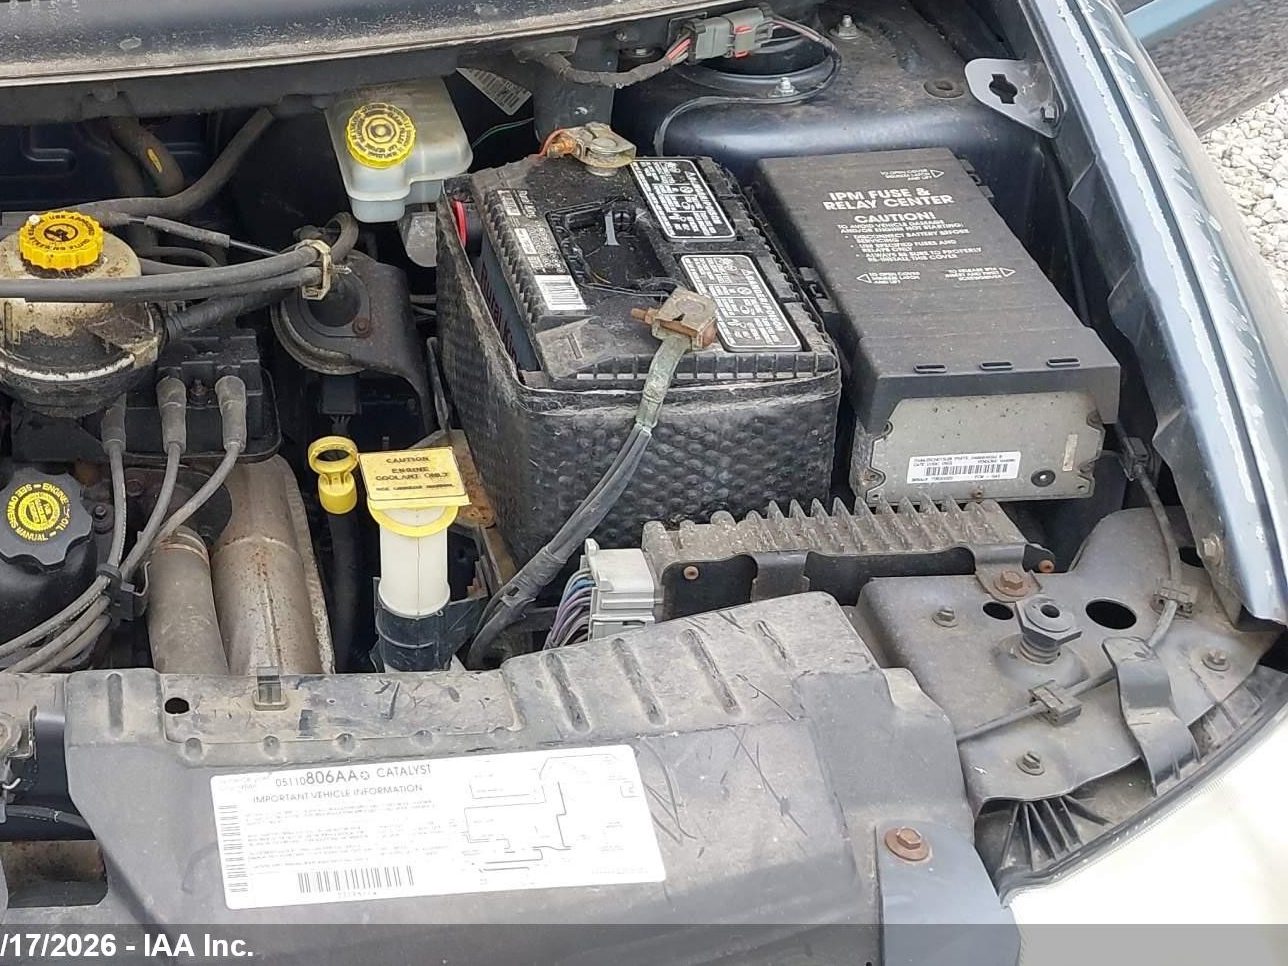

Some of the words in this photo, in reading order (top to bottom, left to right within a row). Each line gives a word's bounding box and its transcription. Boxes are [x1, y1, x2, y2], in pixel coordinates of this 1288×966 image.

[829, 191, 866, 201] IPM
[868, 188, 911, 199] FUSE
[915, 187, 931, 197] &
[823, 199, 878, 211] RELAY
[883, 194, 955, 208] CENTER
[854, 211, 936, 224] CAUTION!
[386, 456, 431, 464] CAUTION
[15, 484, 33, 499] SEE
[42, 482, 70, 505] ENGINE
[55, 517, 70, 531] OIL
[15, 526, 49, 542] MANUAL
[376, 764, 433, 778] CATALYST
[252, 792, 309, 804] IMPORTANT
[310, 789, 350, 800] VEHICLE
[353, 784, 424, 797] INFORMATION
